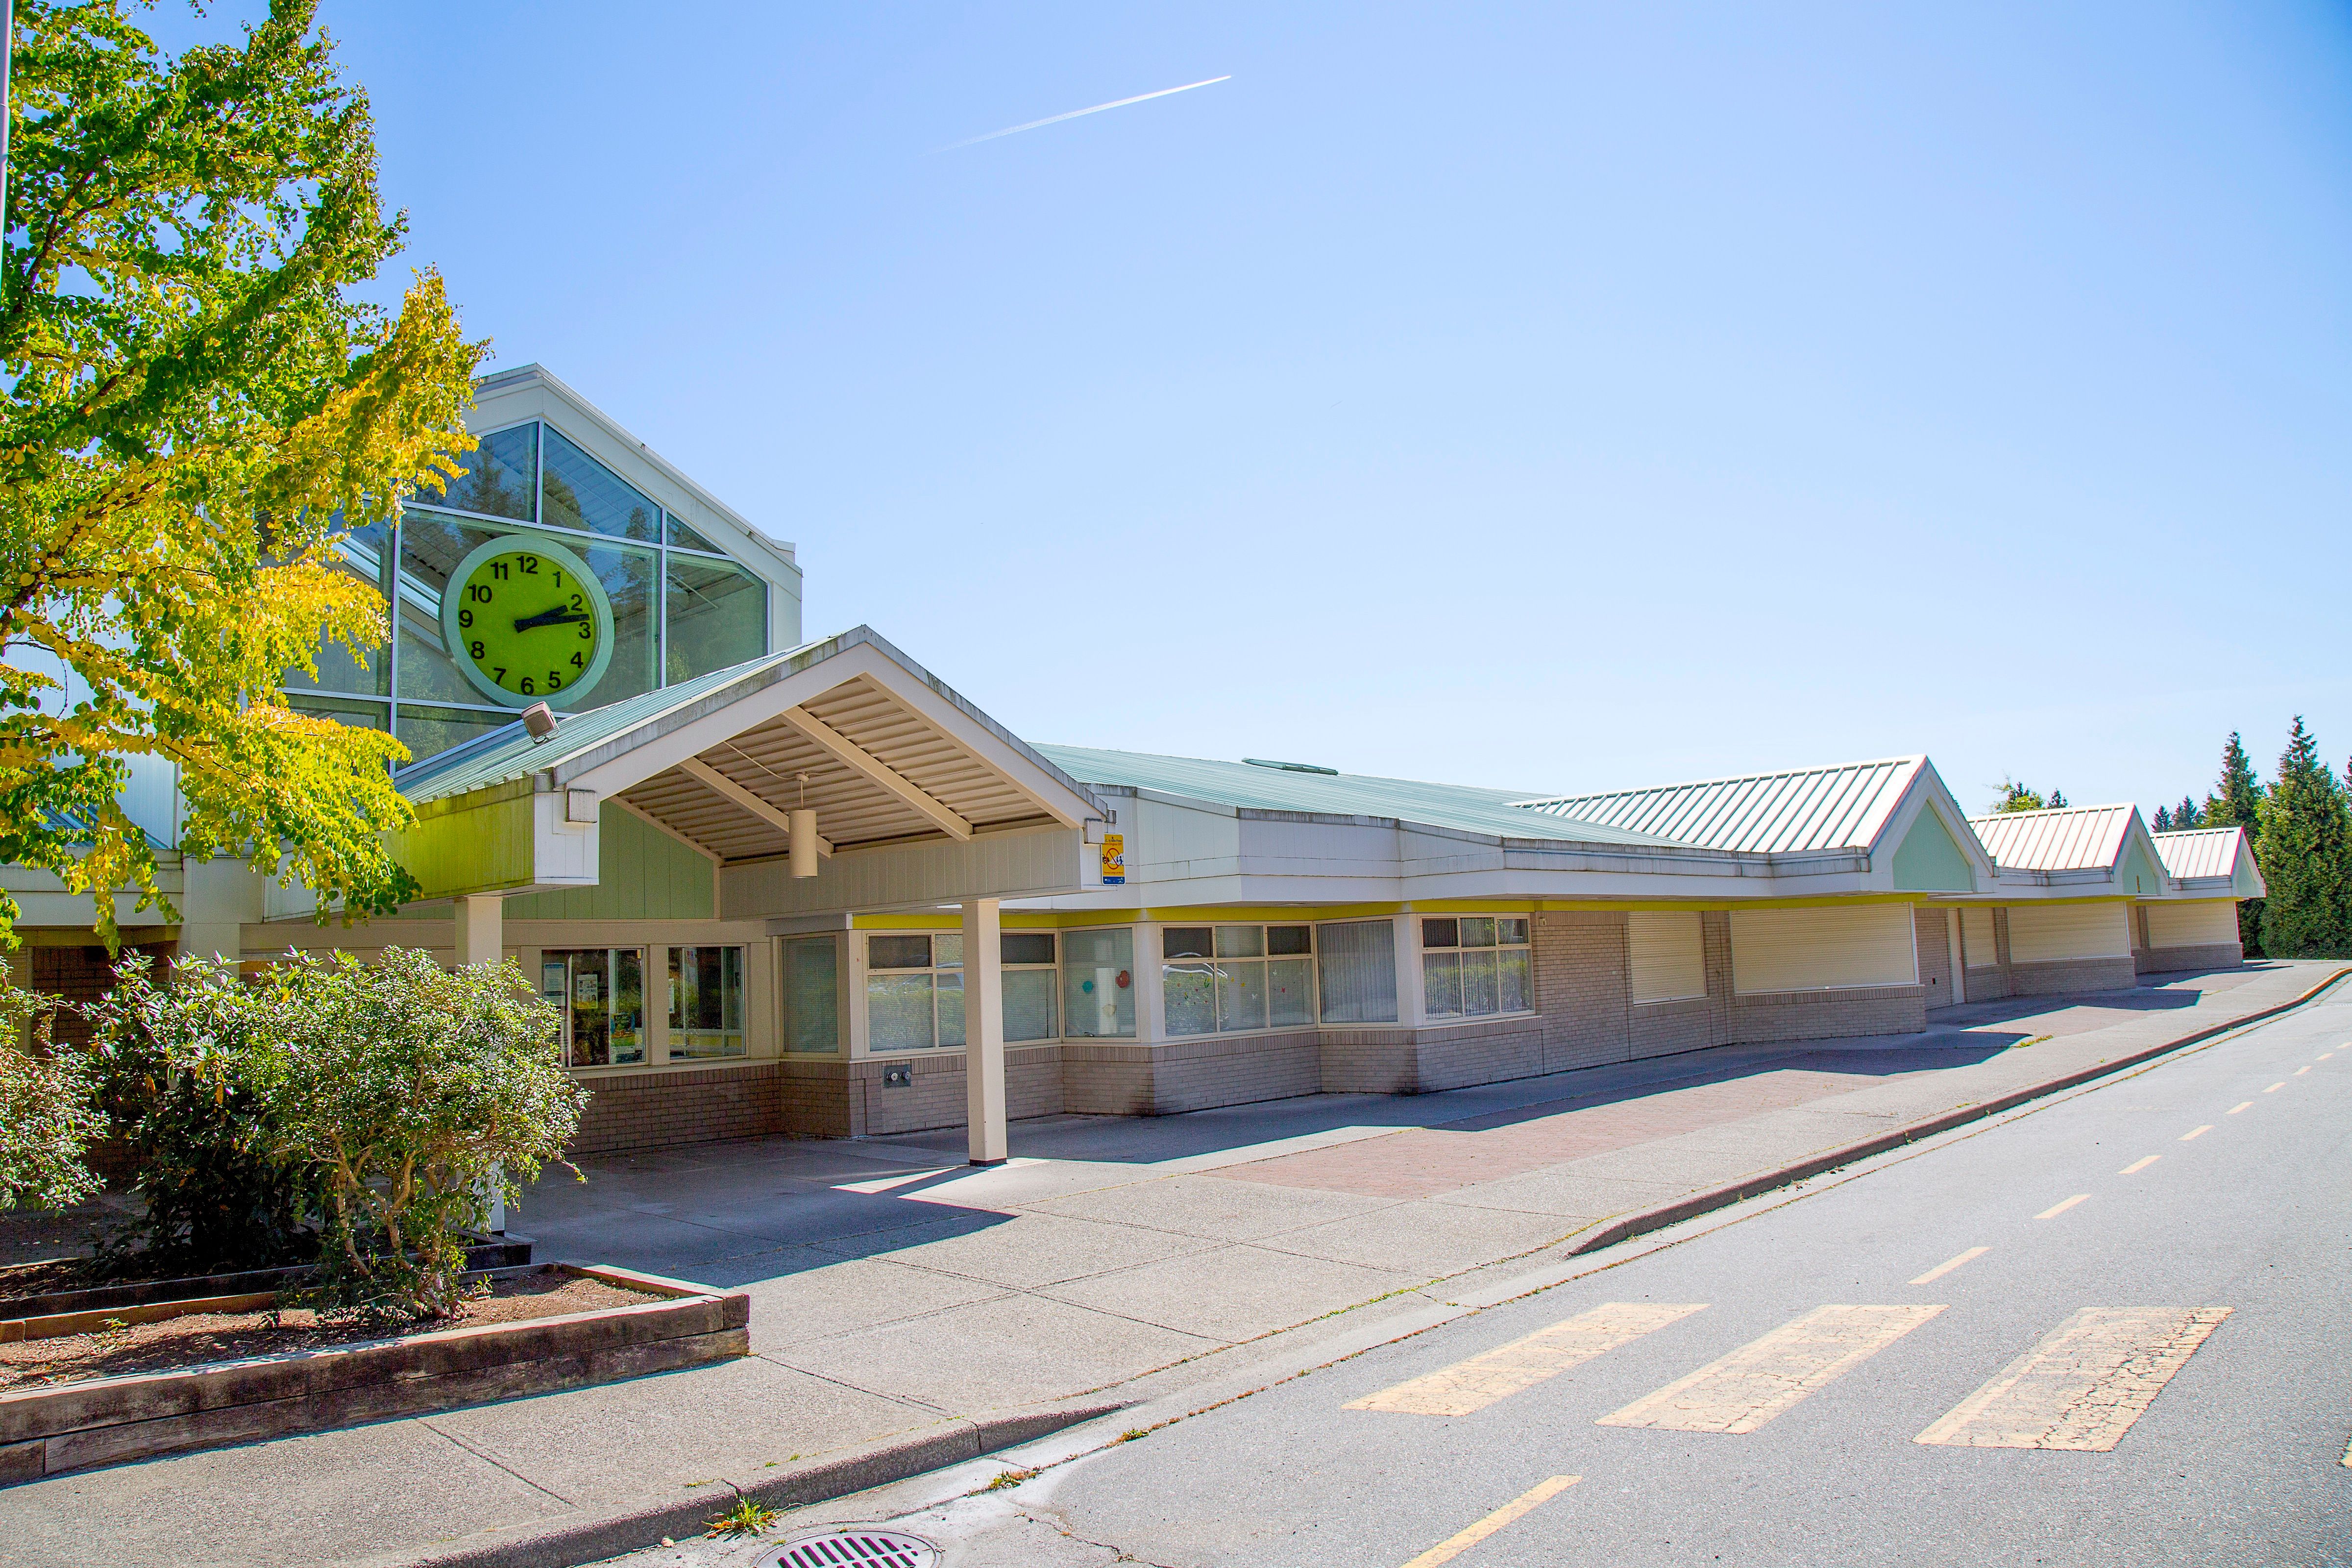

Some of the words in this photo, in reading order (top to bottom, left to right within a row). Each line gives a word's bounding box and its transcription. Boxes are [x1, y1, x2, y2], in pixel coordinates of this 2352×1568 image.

[490, 562, 508, 580] 11
[516, 555, 538, 575] 12
[552, 571, 561, 588] 1
[467, 584, 492, 604] 10
[570, 594, 583, 612] 2
[459, 609, 473, 628] 9
[578, 621, 591, 639] 3
[470, 640, 485, 660] 8
[570, 651, 584, 669] 4
[493, 667, 507, 686] 7
[548, 671, 562, 689] 5
[520, 677, 535, 696] 6
